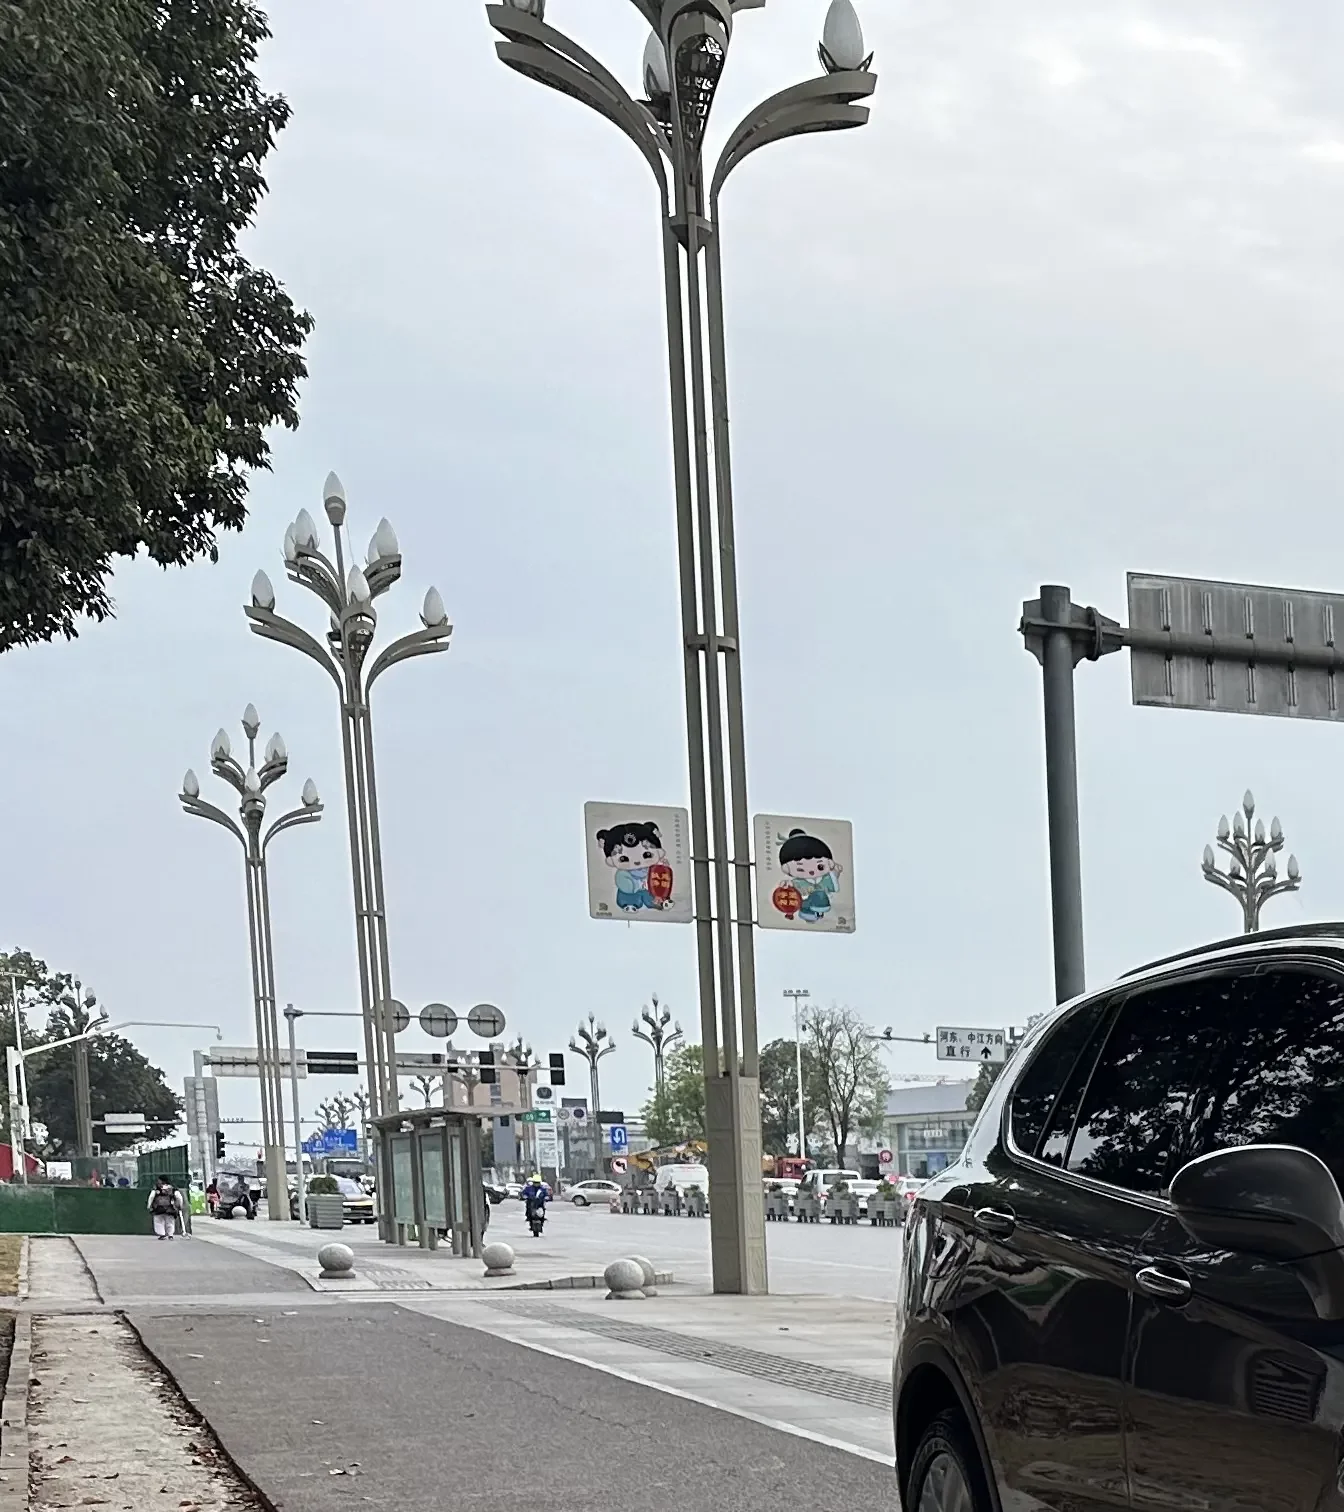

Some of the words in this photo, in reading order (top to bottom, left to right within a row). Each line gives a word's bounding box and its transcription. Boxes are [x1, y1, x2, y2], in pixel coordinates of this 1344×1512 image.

[940, 1030, 1003, 1046] 河东、中江方向
[946, 1045, 971, 1058] 直行
